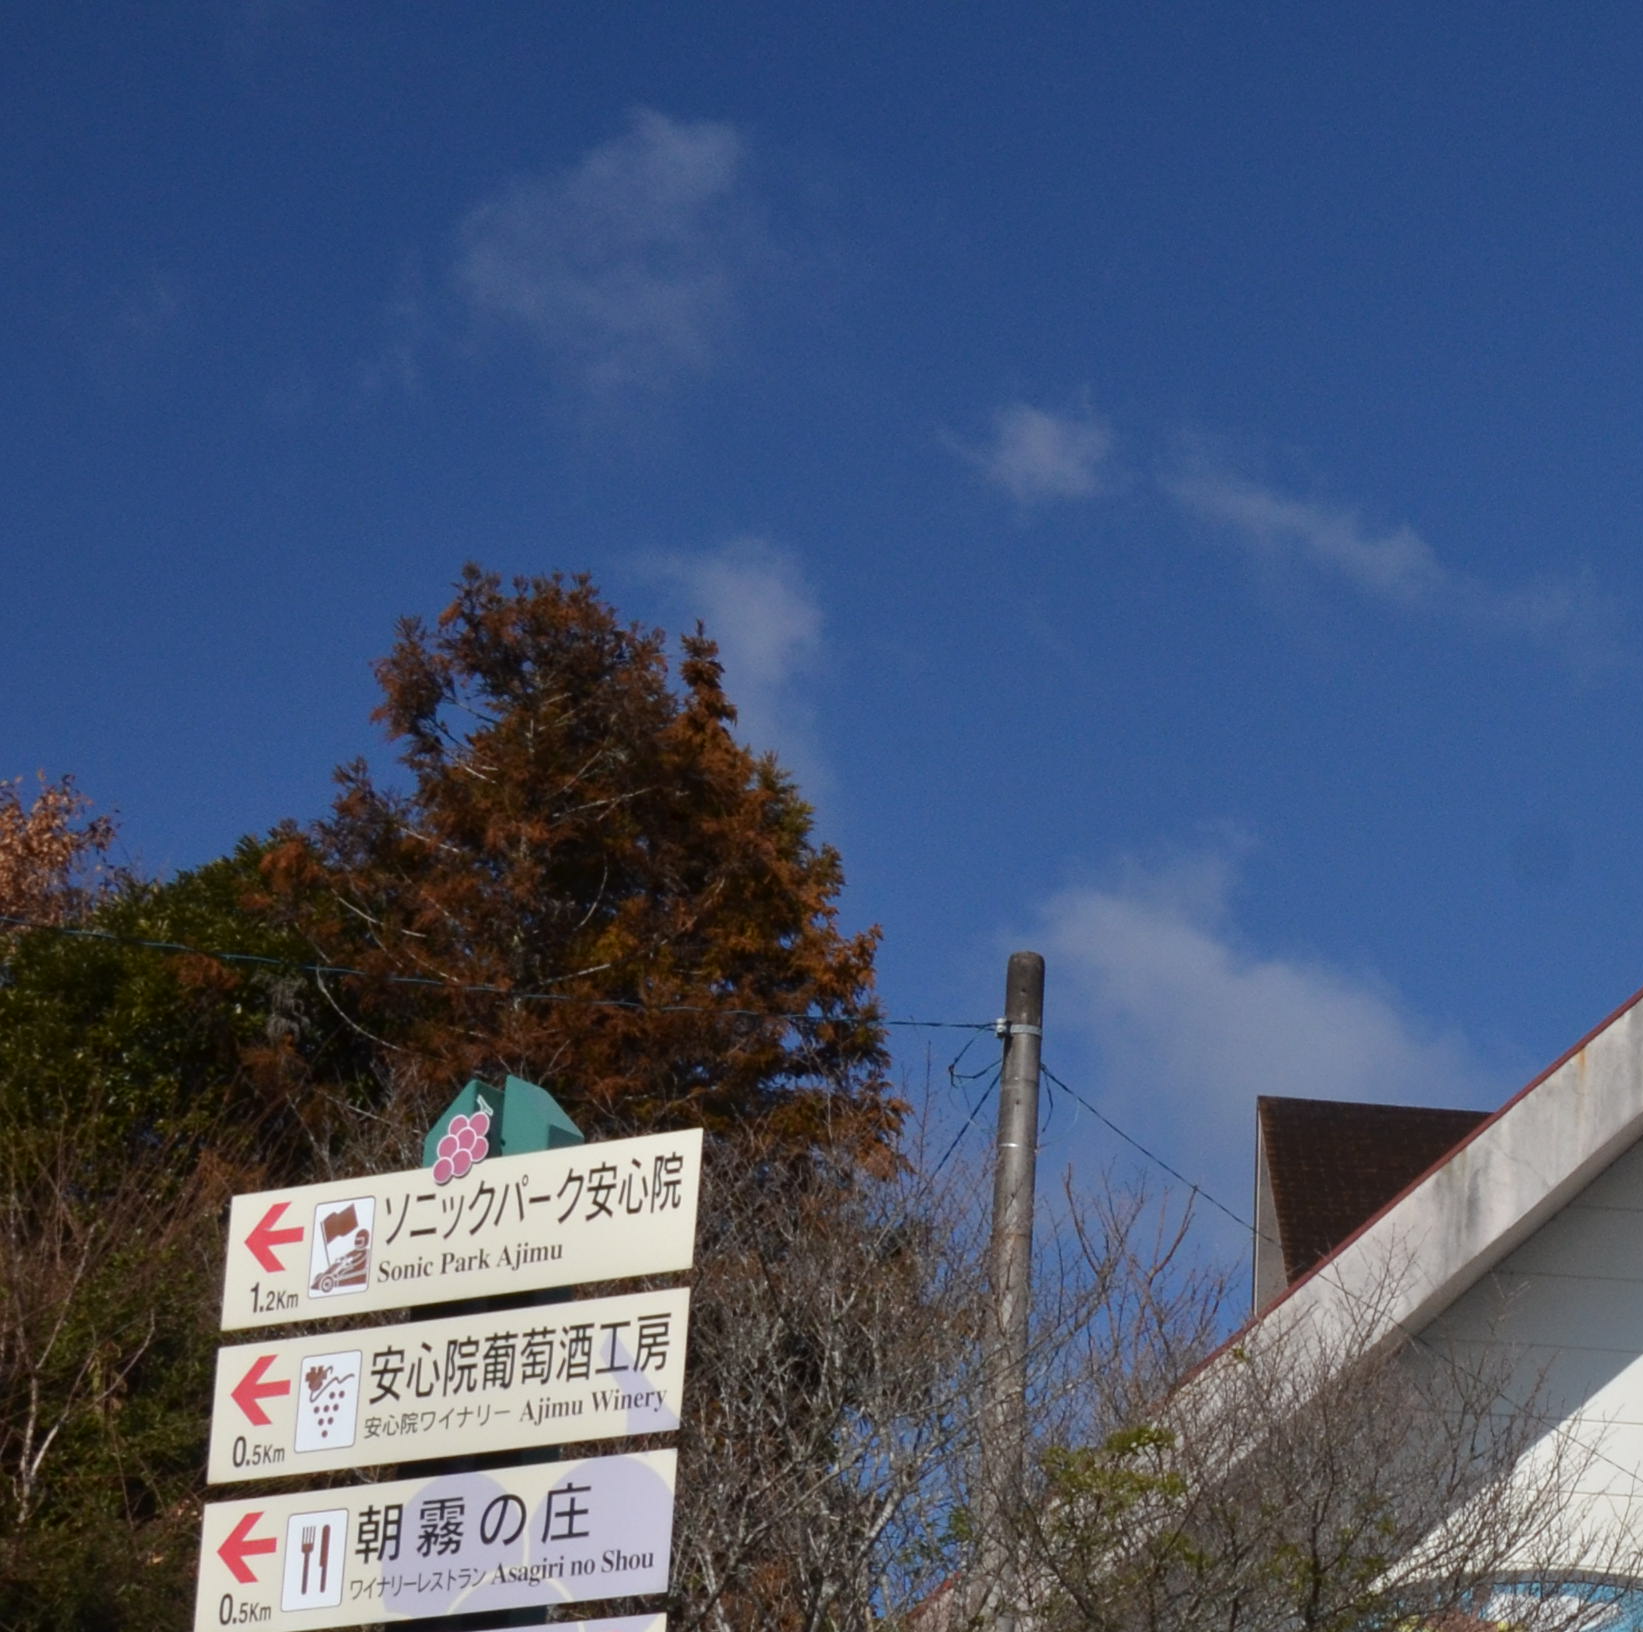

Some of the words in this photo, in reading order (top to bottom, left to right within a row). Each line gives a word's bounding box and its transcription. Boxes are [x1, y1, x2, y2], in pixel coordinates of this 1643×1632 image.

[384, 1152, 684, 1245] ソニックパーク安心院
[377, 1256, 434, 1283] Sonic
[440, 1248, 490, 1275] Park
[496, 1240, 564, 1271] Ajimu
[250, 1281, 299, 1313] 1.2Km
[369, 1312, 671, 1405] 安心院葡萄酒工房
[363, 1407, 511, 1440] 安心院ワイナリー
[519, 1394, 584, 1427] Ajimu
[590, 1387, 667, 1414] Winery
[232, 1435, 285, 1468] 0.5Km
[355, 1482, 592, 1565] 朝霧の庄
[350, 1567, 488, 1601] ワイナリーレストラン
[491, 1556, 565, 1588] Asagiri
[569, 1558, 596, 1576] no
[601, 1548, 655, 1574] Shou
[219, 1594, 272, 1625] 0.5Km
